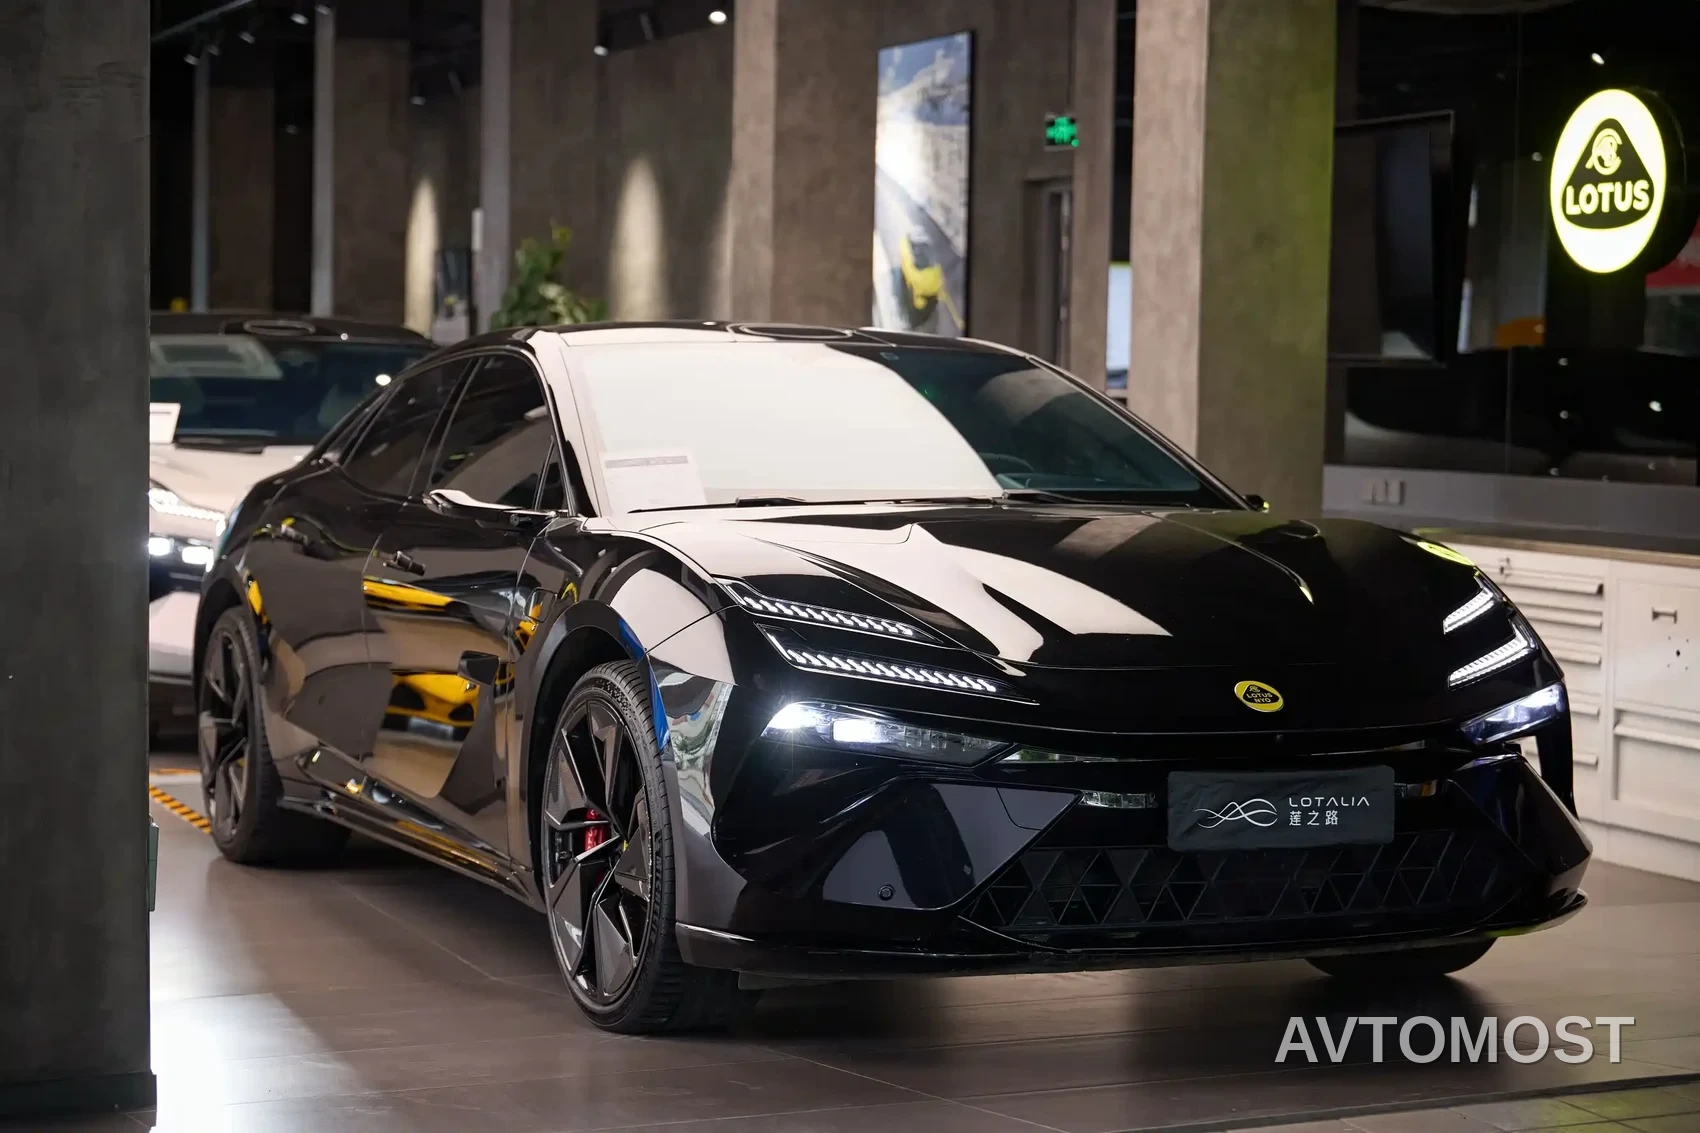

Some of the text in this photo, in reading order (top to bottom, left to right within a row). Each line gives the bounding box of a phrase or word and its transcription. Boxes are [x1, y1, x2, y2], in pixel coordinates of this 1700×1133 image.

[1565, 179, 1650, 215] LOTUS
[1288, 796, 1370, 807] LOTALIA
[1288, 810, 1338, 826] 莲之路
[650, 856, 662, 943] MICHELIN
